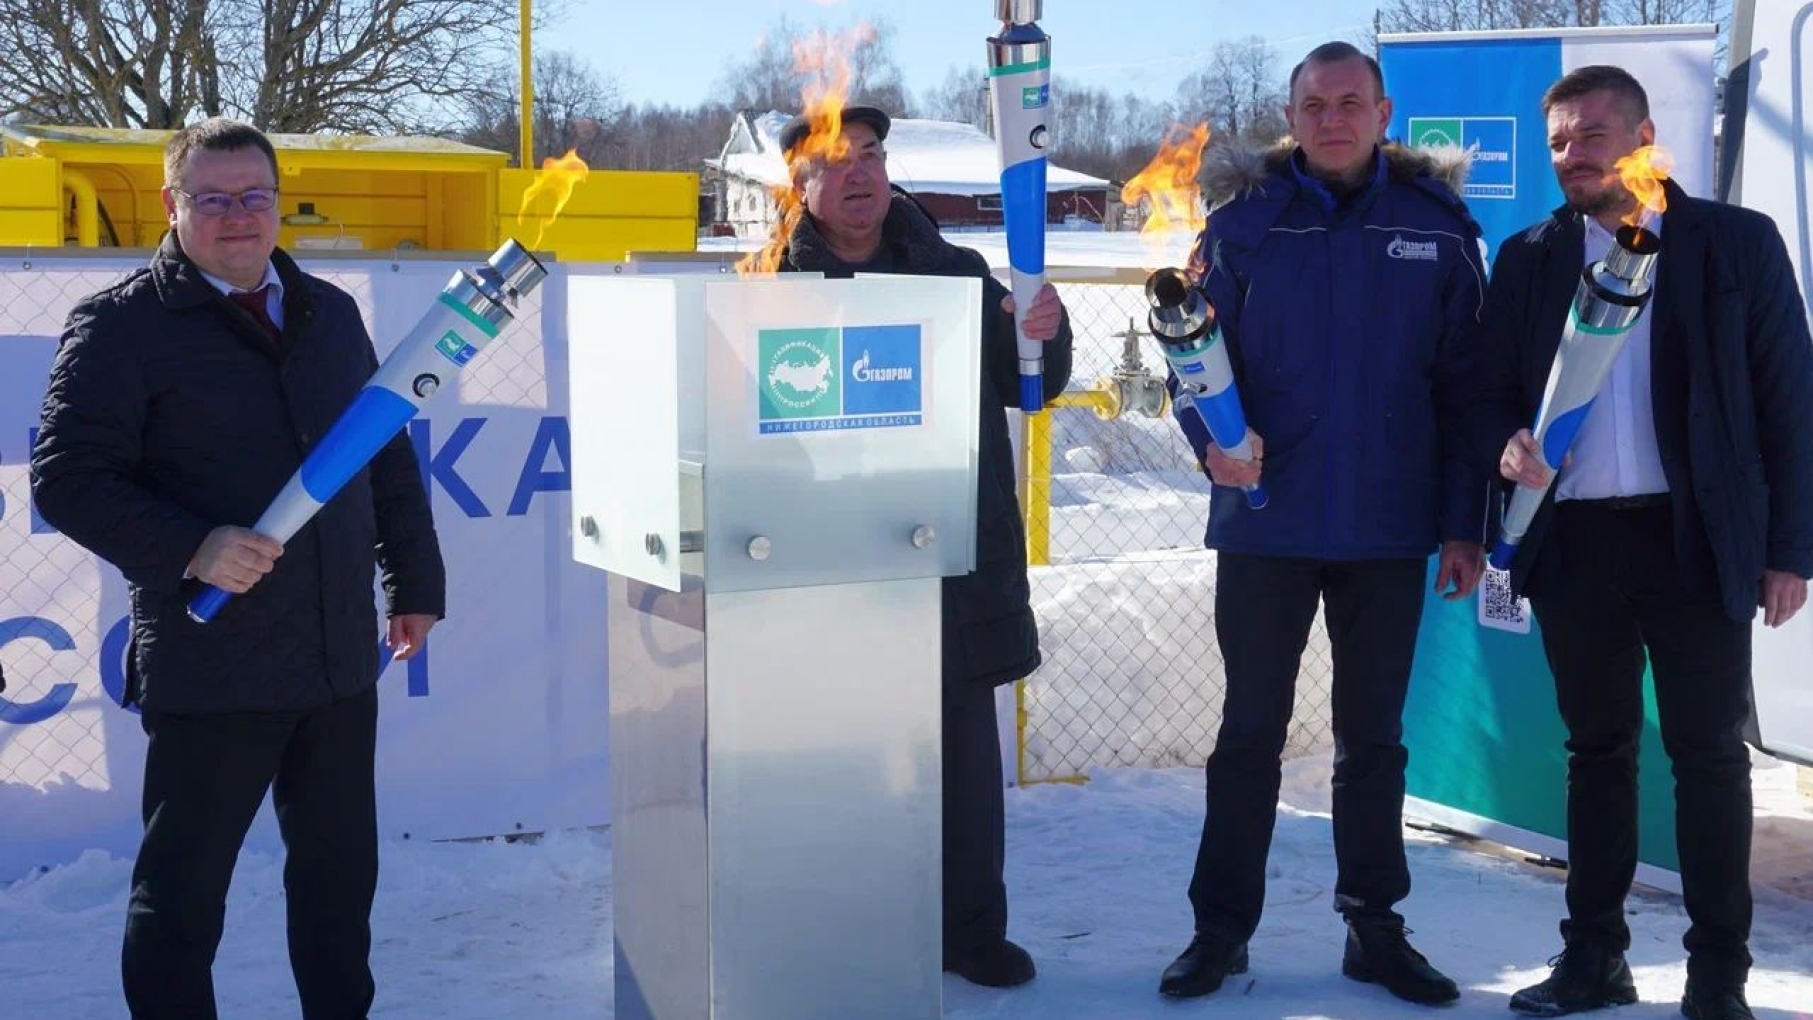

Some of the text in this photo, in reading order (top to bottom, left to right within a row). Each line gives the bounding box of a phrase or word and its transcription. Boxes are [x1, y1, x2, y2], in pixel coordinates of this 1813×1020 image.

[870, 367, 912, 382] ГАЗПРОМ
[767, 415, 915, 431] НИЖЕГОРОДСКАЯ ОБЛАСТЬ
